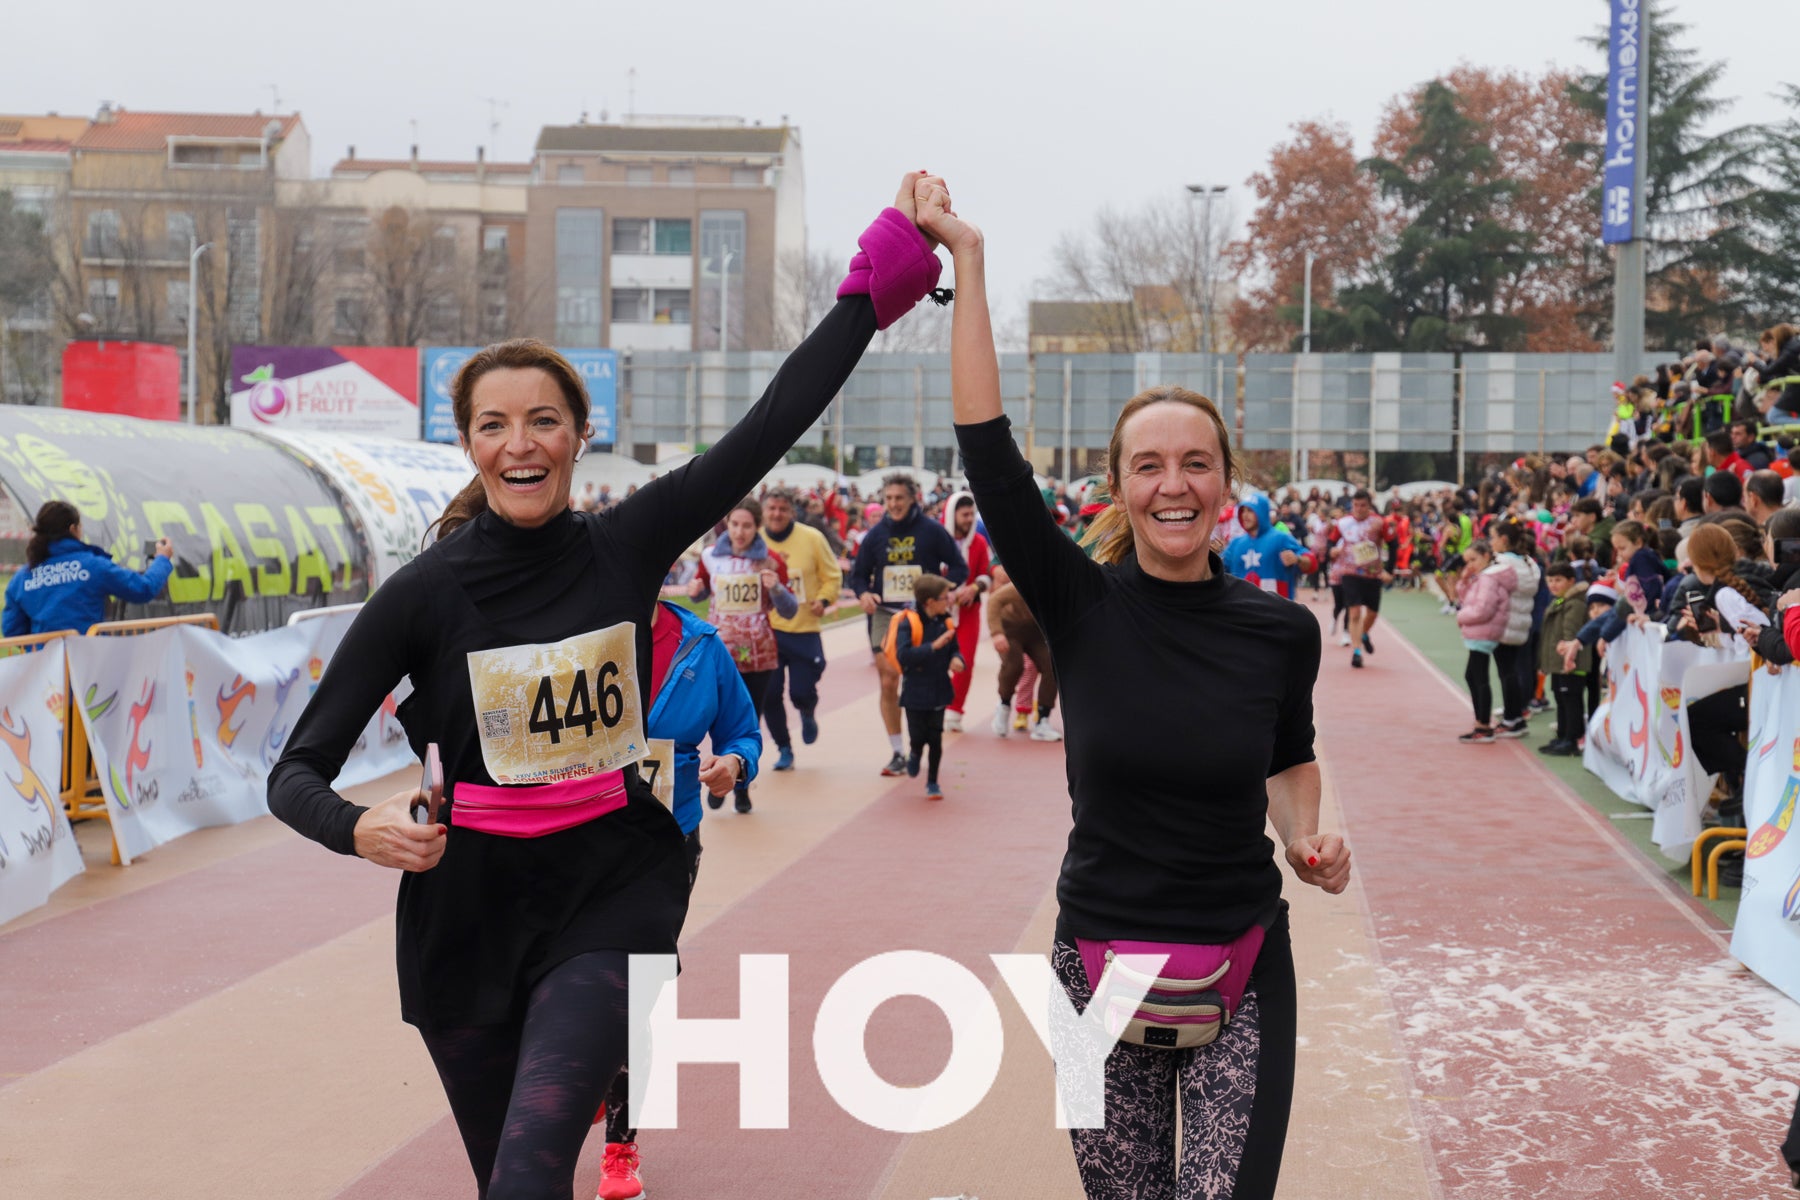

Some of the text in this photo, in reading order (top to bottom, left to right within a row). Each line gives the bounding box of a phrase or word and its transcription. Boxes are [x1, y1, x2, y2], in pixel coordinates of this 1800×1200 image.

[297, 376, 357, 396] LAND
[297, 393, 356, 414] FRUIT
[143, 501, 353, 604] CASAT
[24, 570, 90, 592] DEPORTIVO
[724, 583, 759, 603] 1023
[529, 660, 623, 744] 446
[533, 770, 548, 778] SAN
[550, 762, 587, 775] SILVESTRE
